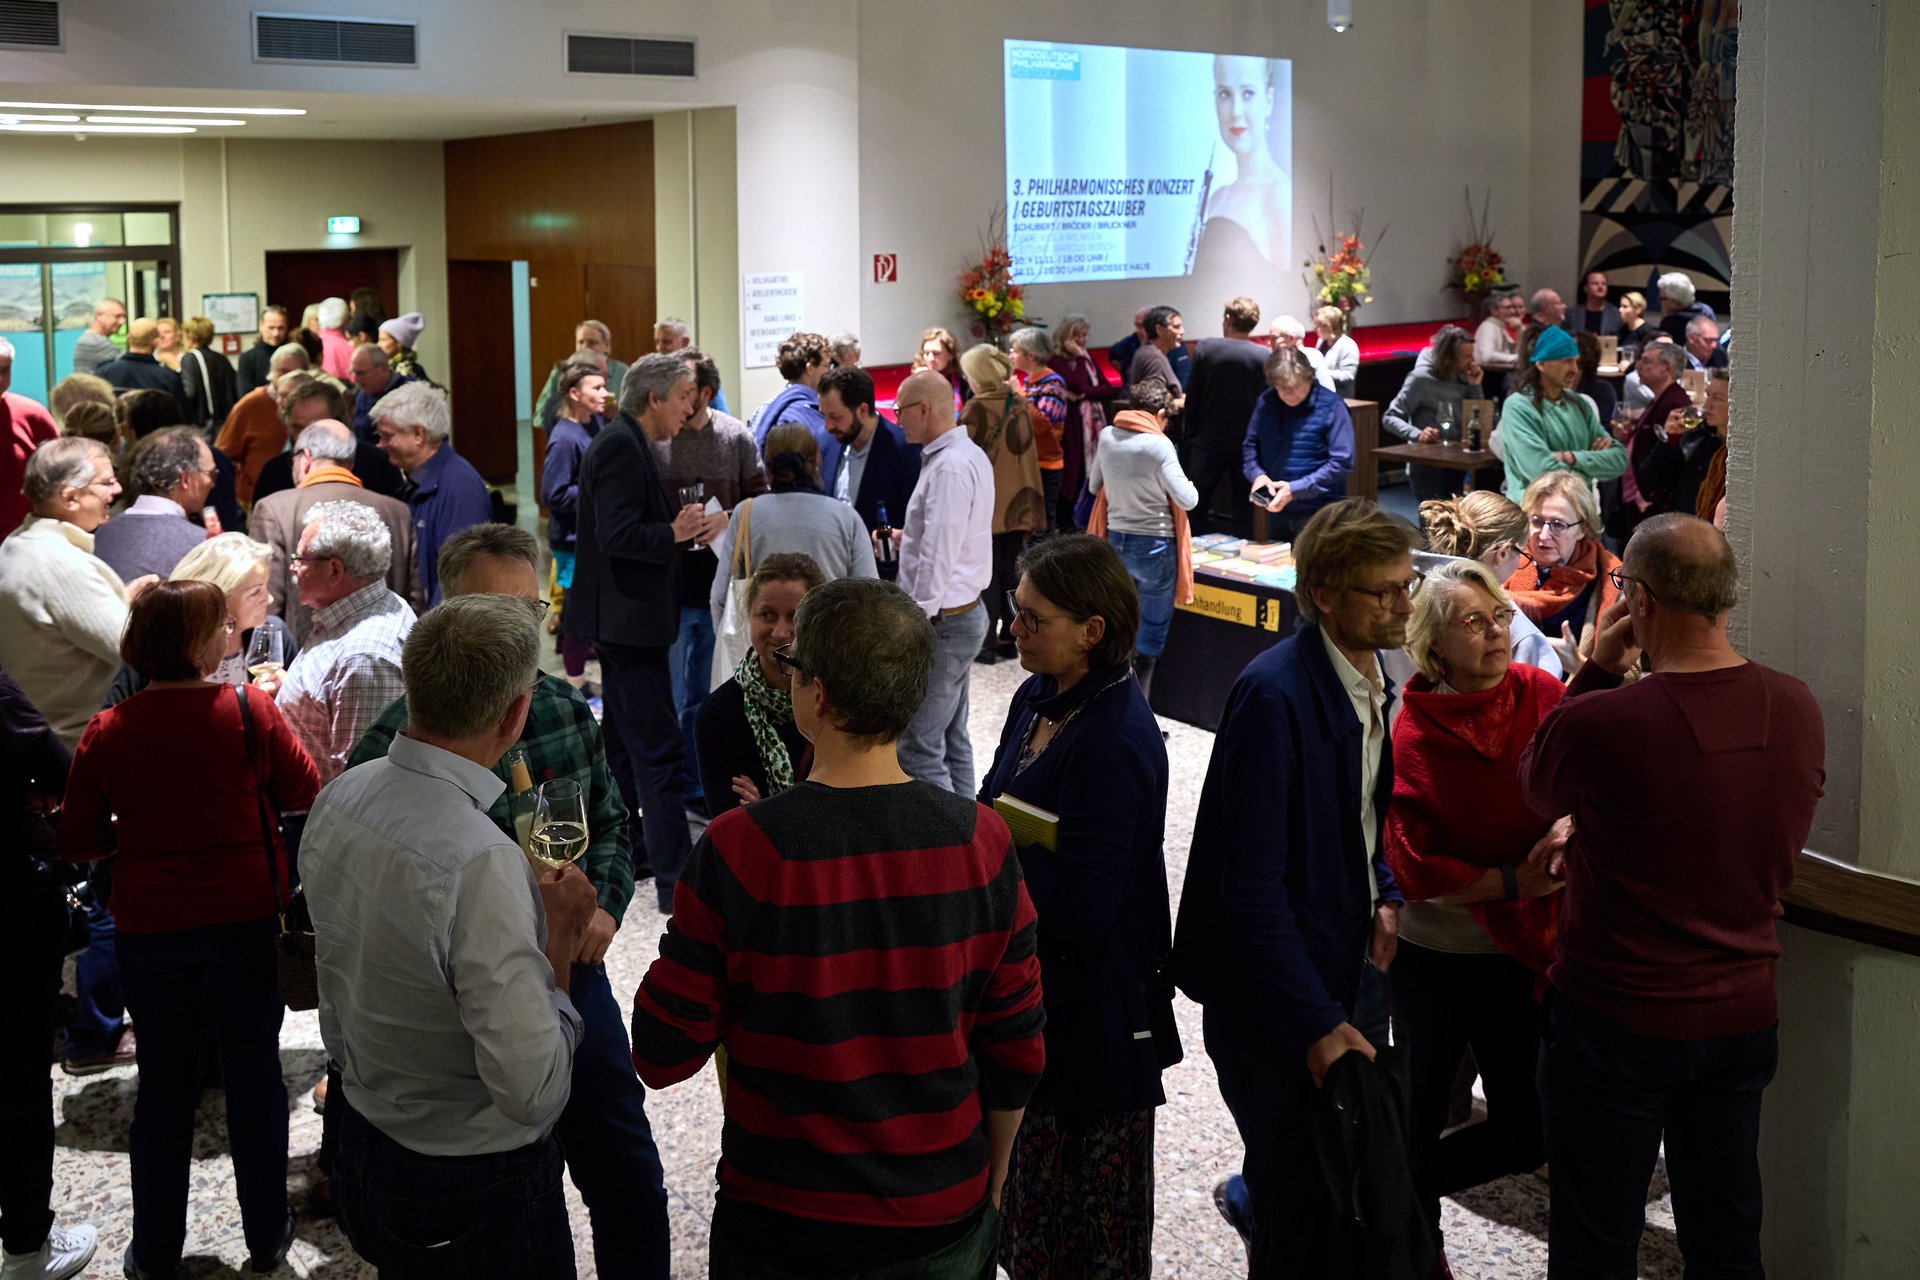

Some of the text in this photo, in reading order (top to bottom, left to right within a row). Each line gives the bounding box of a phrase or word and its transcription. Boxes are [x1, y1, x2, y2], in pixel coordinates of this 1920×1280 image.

[1013, 178, 1195, 196] 3. PHILHARMONISCHES KONZERT
[1021, 200, 1146, 218] GEBURTSTAGSZAUBER
[1014, 222, 1055, 232] SCHUBERT
[1098, 220, 1138, 230] BRUCKNER
[1087, 254, 1103, 262] UHR
[1067, 265, 1084, 273] UHR
[1129, 262, 1151, 271] HAUS
[1183, 594, 1242, 621] hhandlung
